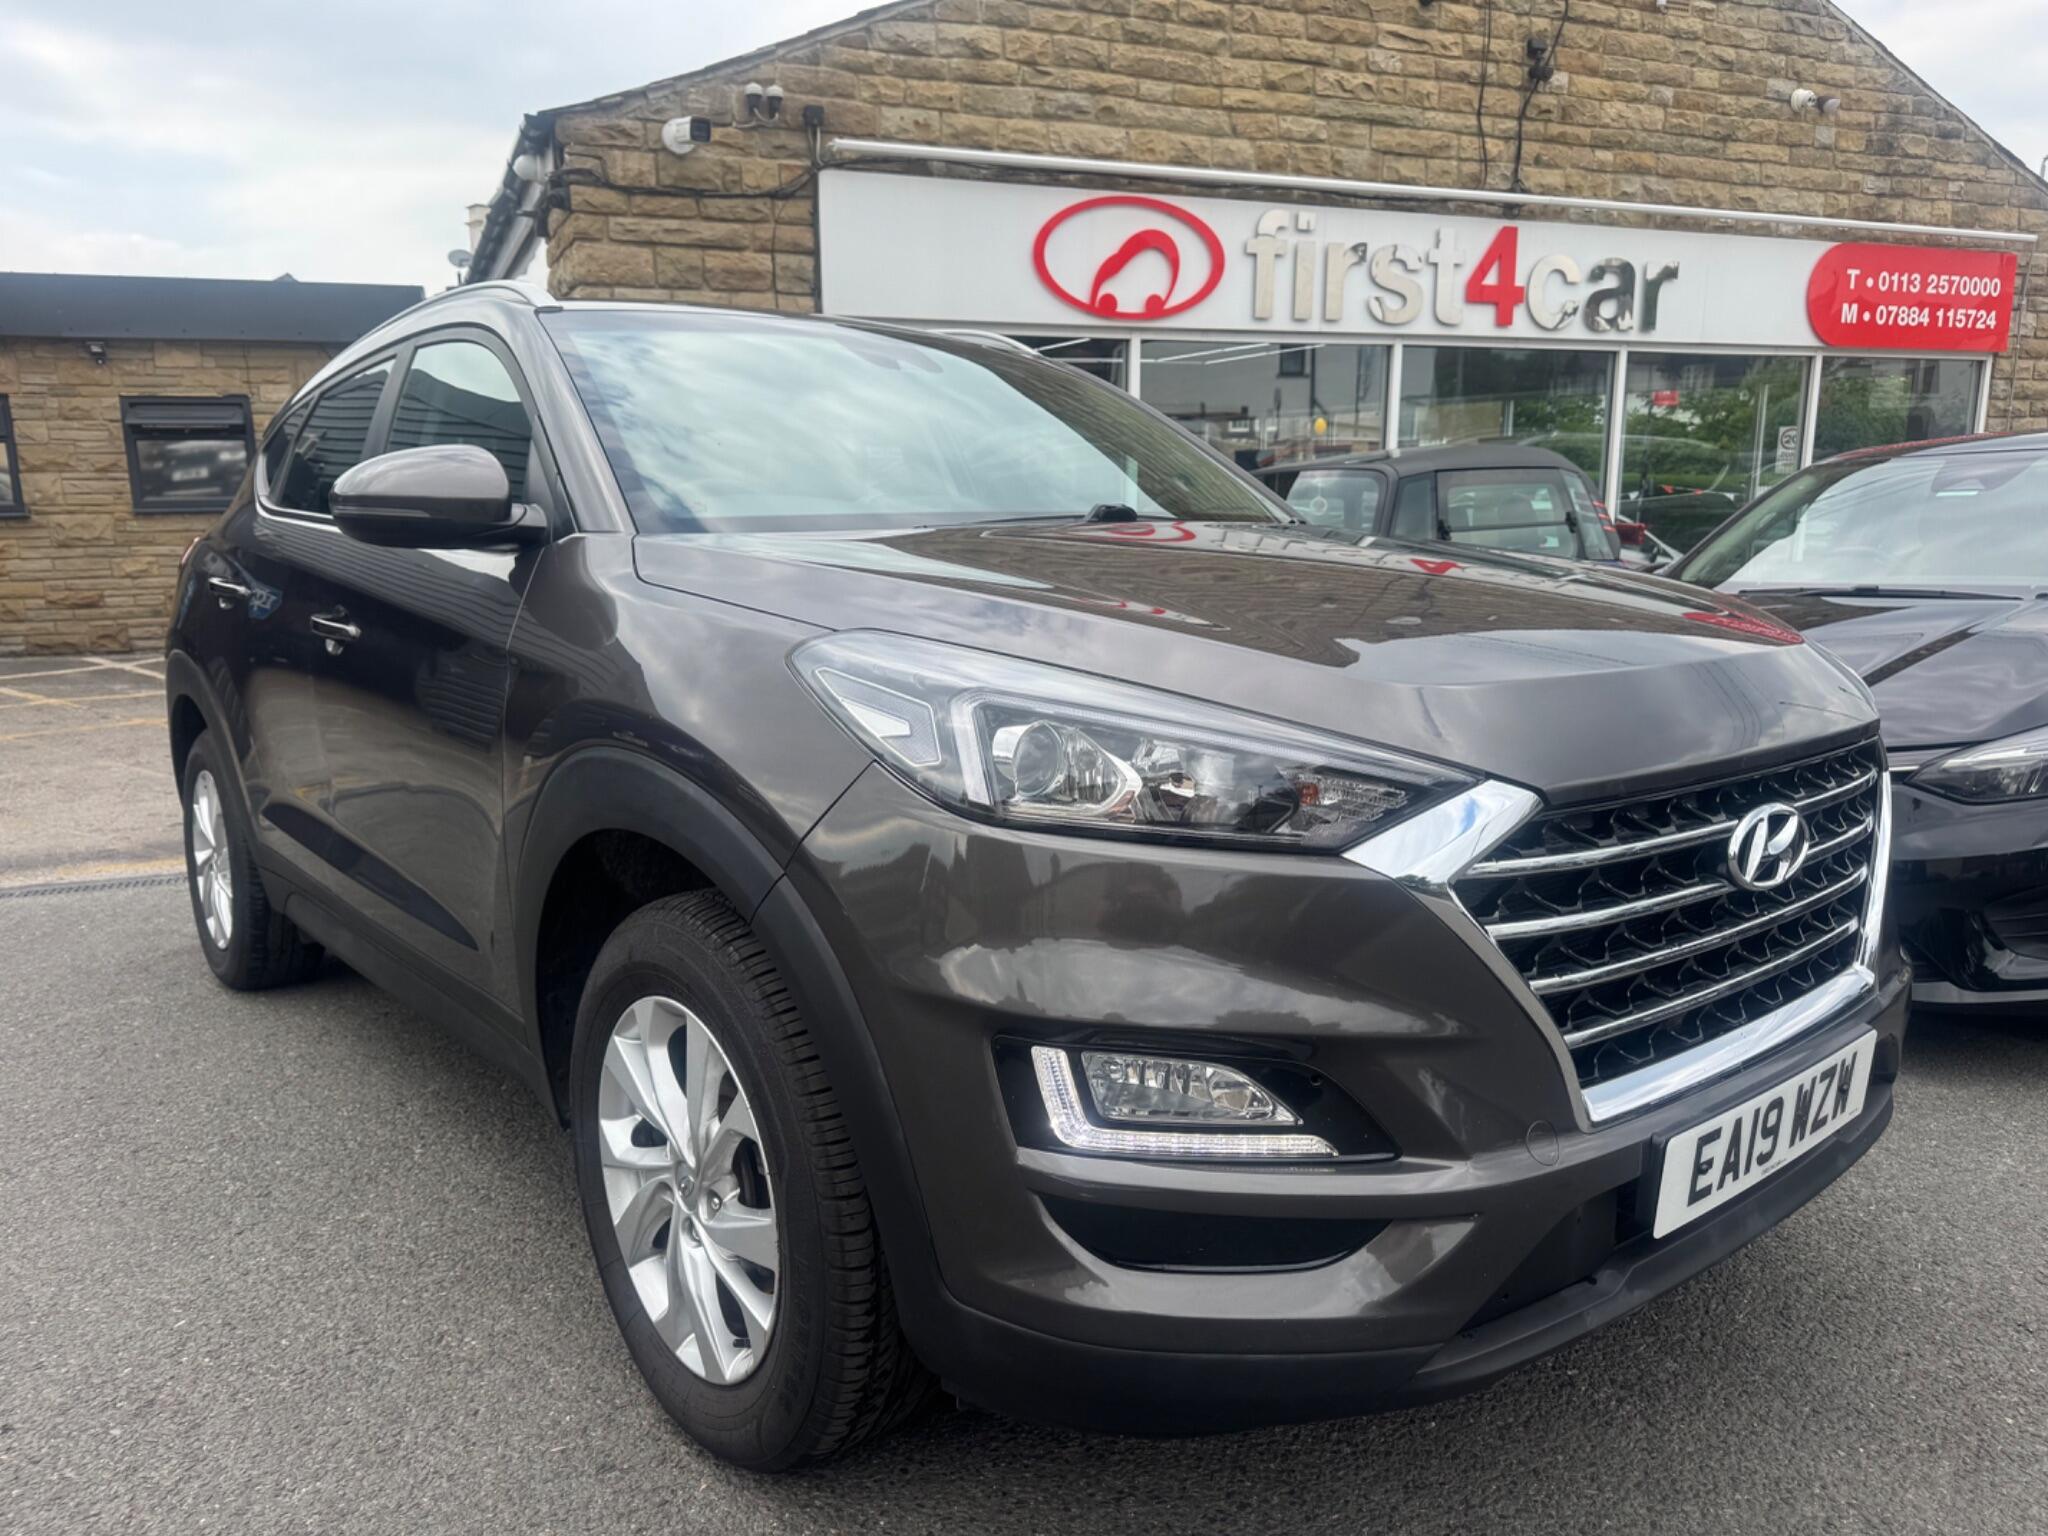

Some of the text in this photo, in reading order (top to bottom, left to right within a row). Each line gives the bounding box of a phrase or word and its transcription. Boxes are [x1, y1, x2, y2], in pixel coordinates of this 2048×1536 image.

[1244, 208, 1680, 334] first4car
[1846, 268, 2002, 298] T 0113 2570000
[1840, 302, 1997, 330] M 07884 115724
[1687, 1051, 1858, 1208] EA19 WZW
